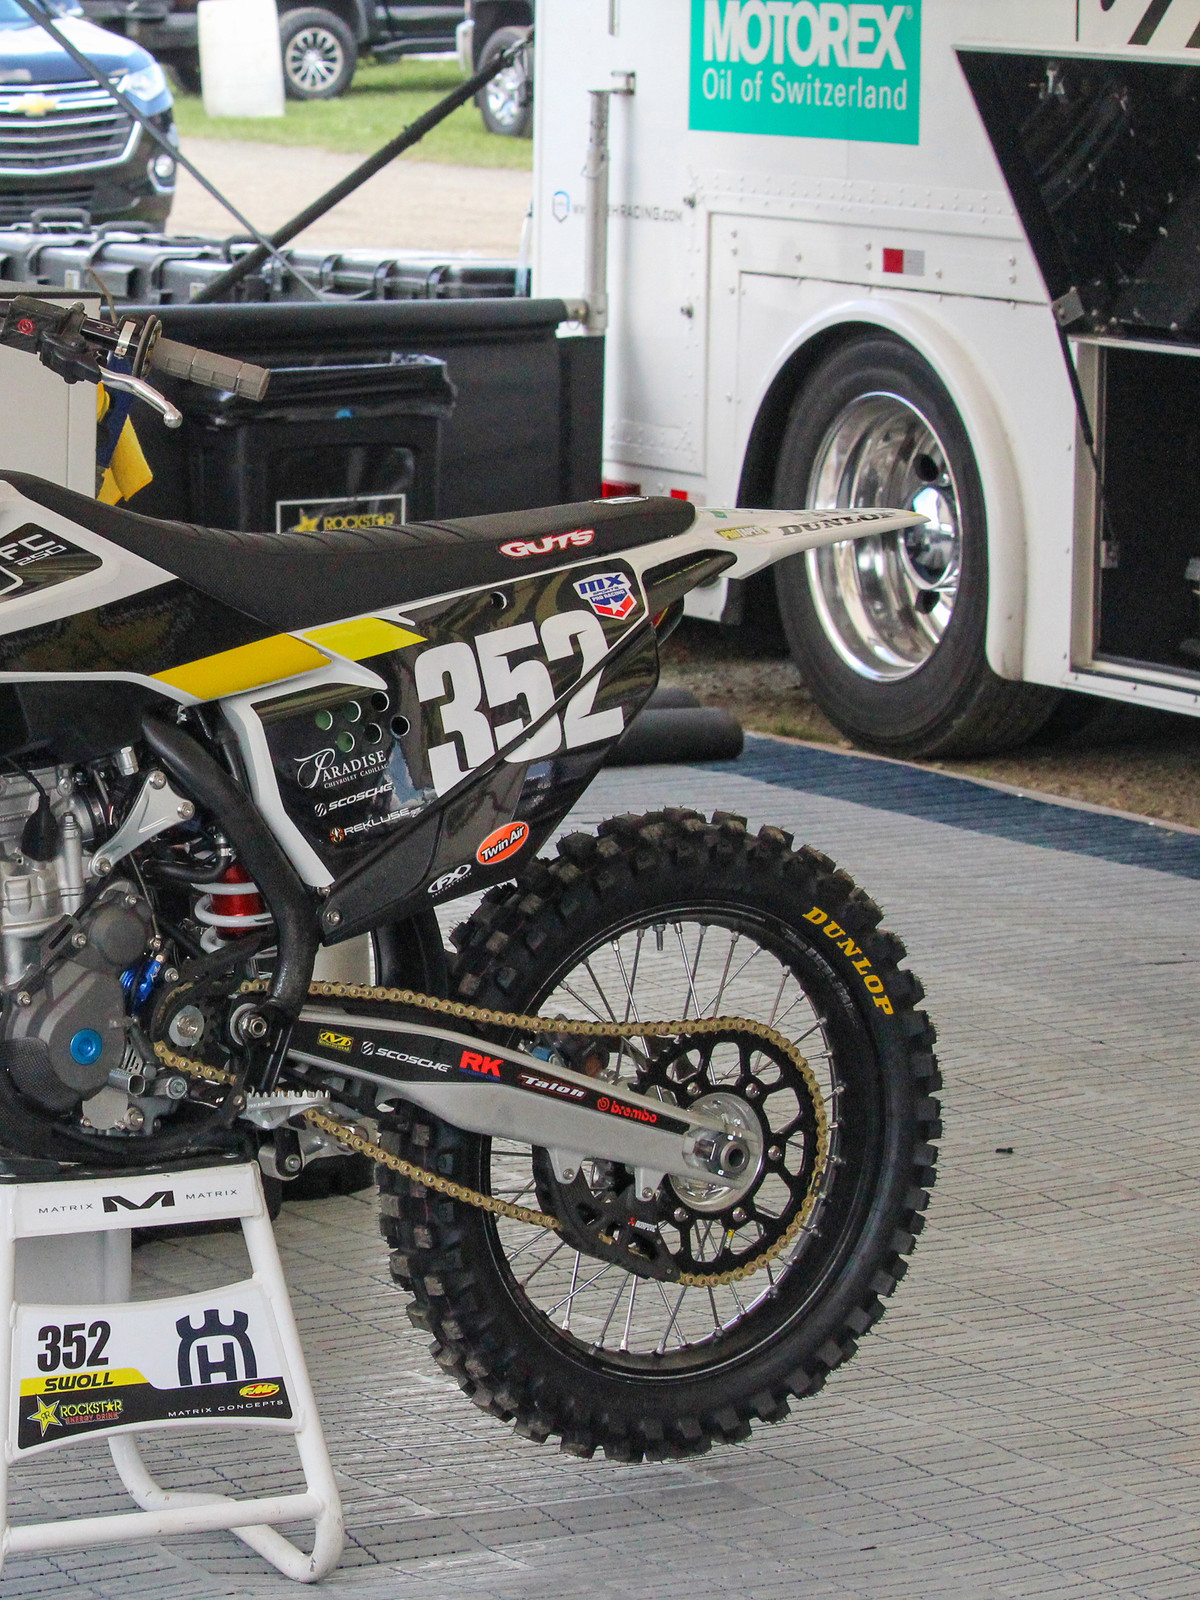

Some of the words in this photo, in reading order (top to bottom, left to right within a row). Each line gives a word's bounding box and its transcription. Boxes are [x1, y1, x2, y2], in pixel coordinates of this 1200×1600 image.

[703, 0, 906, 70] MOTOREX
[703, 68, 731, 101] Oil
[741, 70, 763, 103] of
[771, 72, 907, 111] Switzerland
[778, 511, 897, 536] DUNLOP
[14, 545, 67, 566] 250
[499, 528, 595, 558] GUTS
[579, 574, 625, 595] MX
[414, 610, 624, 798] 352
[294, 748, 387, 789] PARADISE
[329, 782, 394, 811] SCOSCHE
[344, 807, 411, 836] REKLUSE
[481, 838, 509, 861] Twin
[509, 825, 525, 845] Air
[802, 907, 895, 1015] DUNLOP
[375, 1048, 452, 1073] SCOSCHE
[459, 1051, 504, 1077] RK
[521, 1074, 585, 1098] Talon
[611, 1101, 657, 1123] brembo
[38, 1203, 94, 1215] MATRIX
[185, 1188, 238, 1201] MATRIX
[37, 1320, 111, 1373] 352
[44, 1372, 114, 1392] SWOLL
[241, 1384, 279, 1398] FMF
[168, 1407, 212, 1418] MATRIX
[217, 1400, 284, 1412] CONCEPTS
